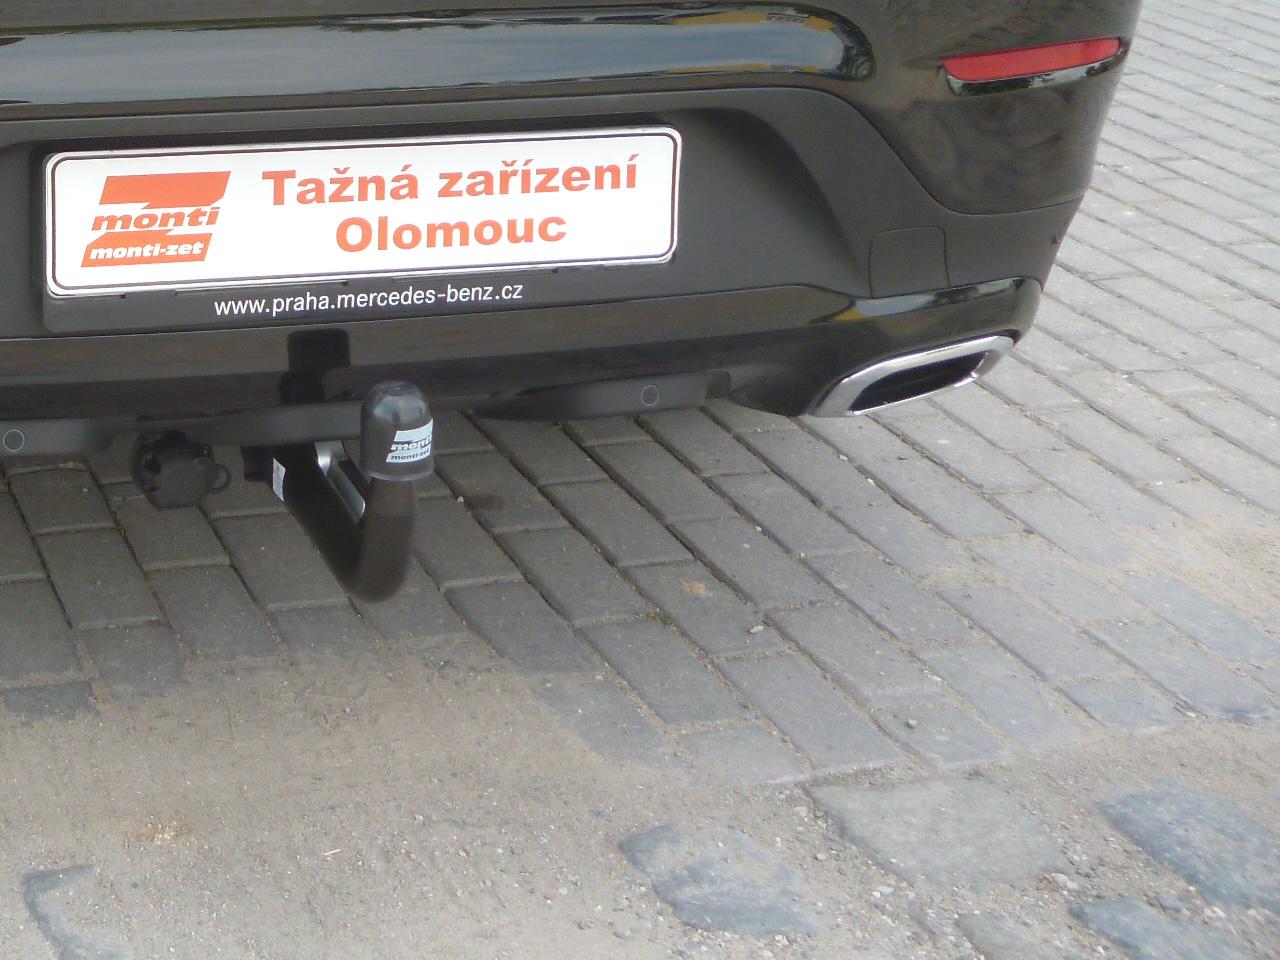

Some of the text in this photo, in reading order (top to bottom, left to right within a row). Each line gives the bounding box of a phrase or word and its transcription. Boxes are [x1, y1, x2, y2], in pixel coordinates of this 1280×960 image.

[261, 153, 639, 206] Tažná zařízení
[91, 206, 221, 231] monti
[336, 215, 568, 253] Olomouc
[89, 241, 205, 260] monti-zet
[214, 283, 524, 317] www.praha.mercedes-benz.cz
